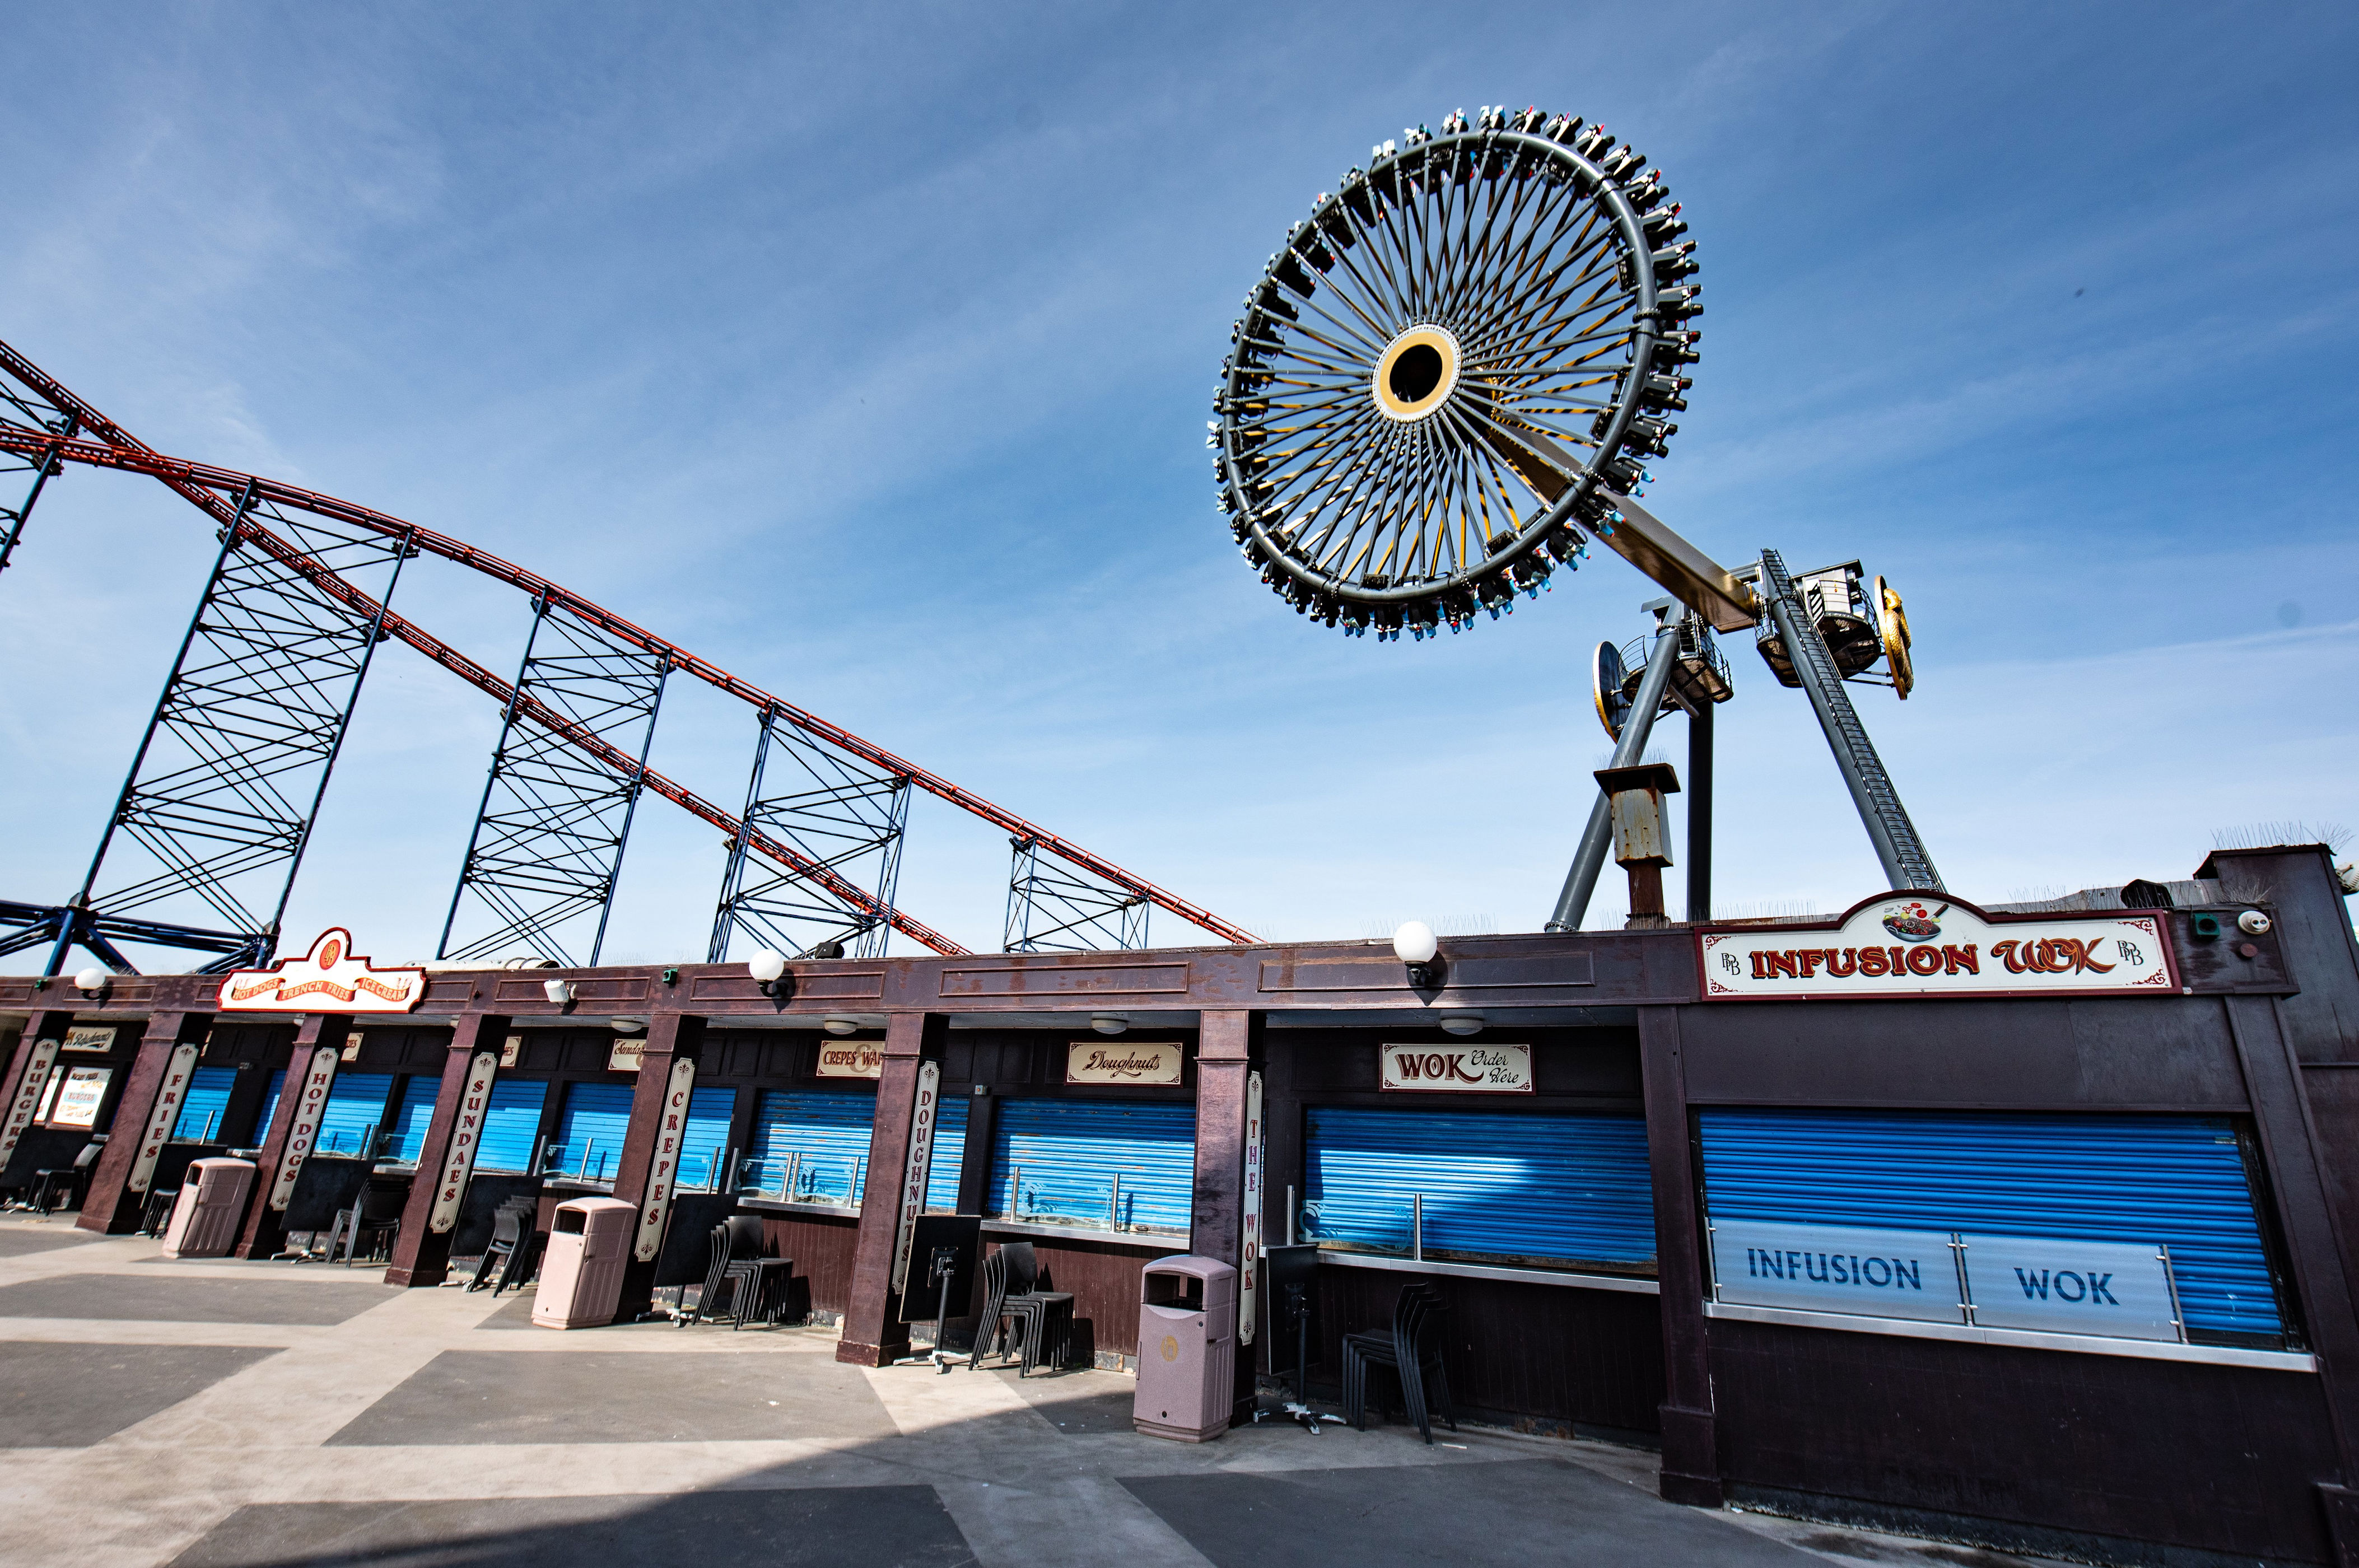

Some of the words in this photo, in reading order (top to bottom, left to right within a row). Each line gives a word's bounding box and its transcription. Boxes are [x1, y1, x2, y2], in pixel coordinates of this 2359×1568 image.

[1748, 944, 1980, 979] INFUSION
[1990, 937, 2116, 976] WOK
[232, 988, 252, 1000] HOT
[252, 979, 279, 996] DOGS
[282, 981, 324, 1000] FRENCH
[326, 983, 350, 1000] FRIES
[361, 978, 377, 992] ICE
[376, 984, 407, 1001] CREAM
[823, 1051, 857, 1065] CREPES
[1082, 1050, 1162, 1079] Doughnuts
[1394, 1054, 1484, 1084] WOK
[1471, 1049, 1508, 1066] Order
[1489, 1067, 1519, 1083] Here
[4, 1060, 46, 1150] BURGERS
[145, 1074, 183, 1159] FRIES
[305, 1073, 328, 1115] HOT
[283, 1123, 312, 1182] DOGS
[443, 1079, 484, 1202] SUNDAES
[647, 1091, 684, 1225] CREPES
[1248, 1119, 1258, 1192] THE
[902, 1090, 931, 1261] DOUGHNUTS
[1244, 1214, 1257, 1291] WOK
[1747, 1248, 1922, 1290] INFUSION
[2013, 1267, 2120, 1306] WOK
